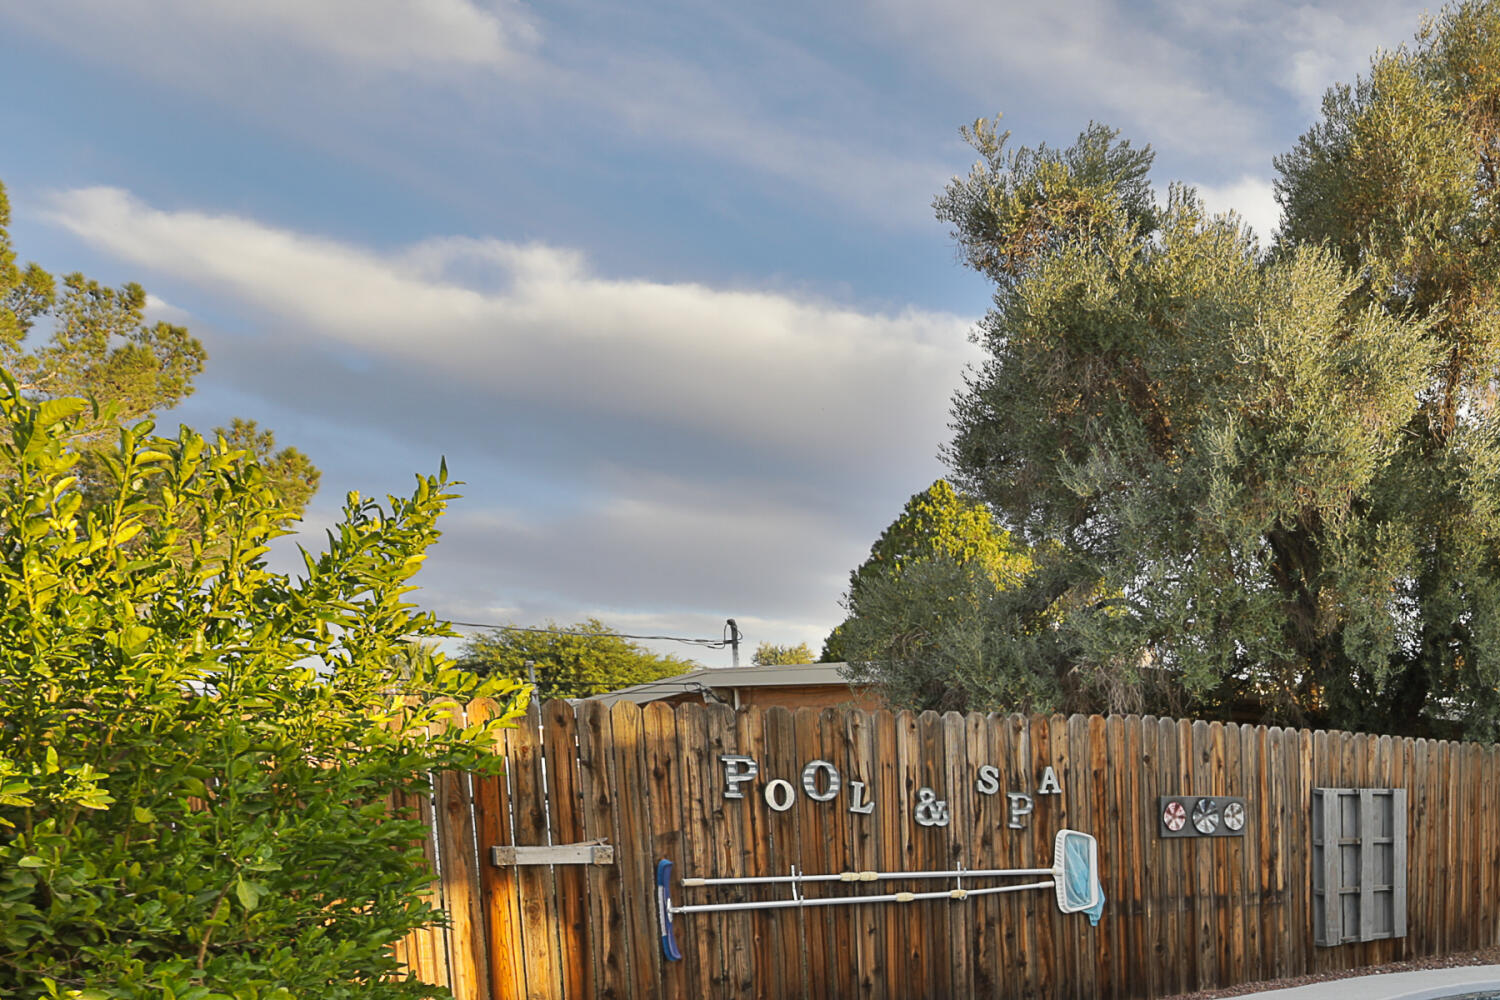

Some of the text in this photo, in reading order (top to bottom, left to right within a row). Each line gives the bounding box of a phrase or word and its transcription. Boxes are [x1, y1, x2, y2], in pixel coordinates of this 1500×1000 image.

[721, 754, 1062, 829] POOL & SPA
